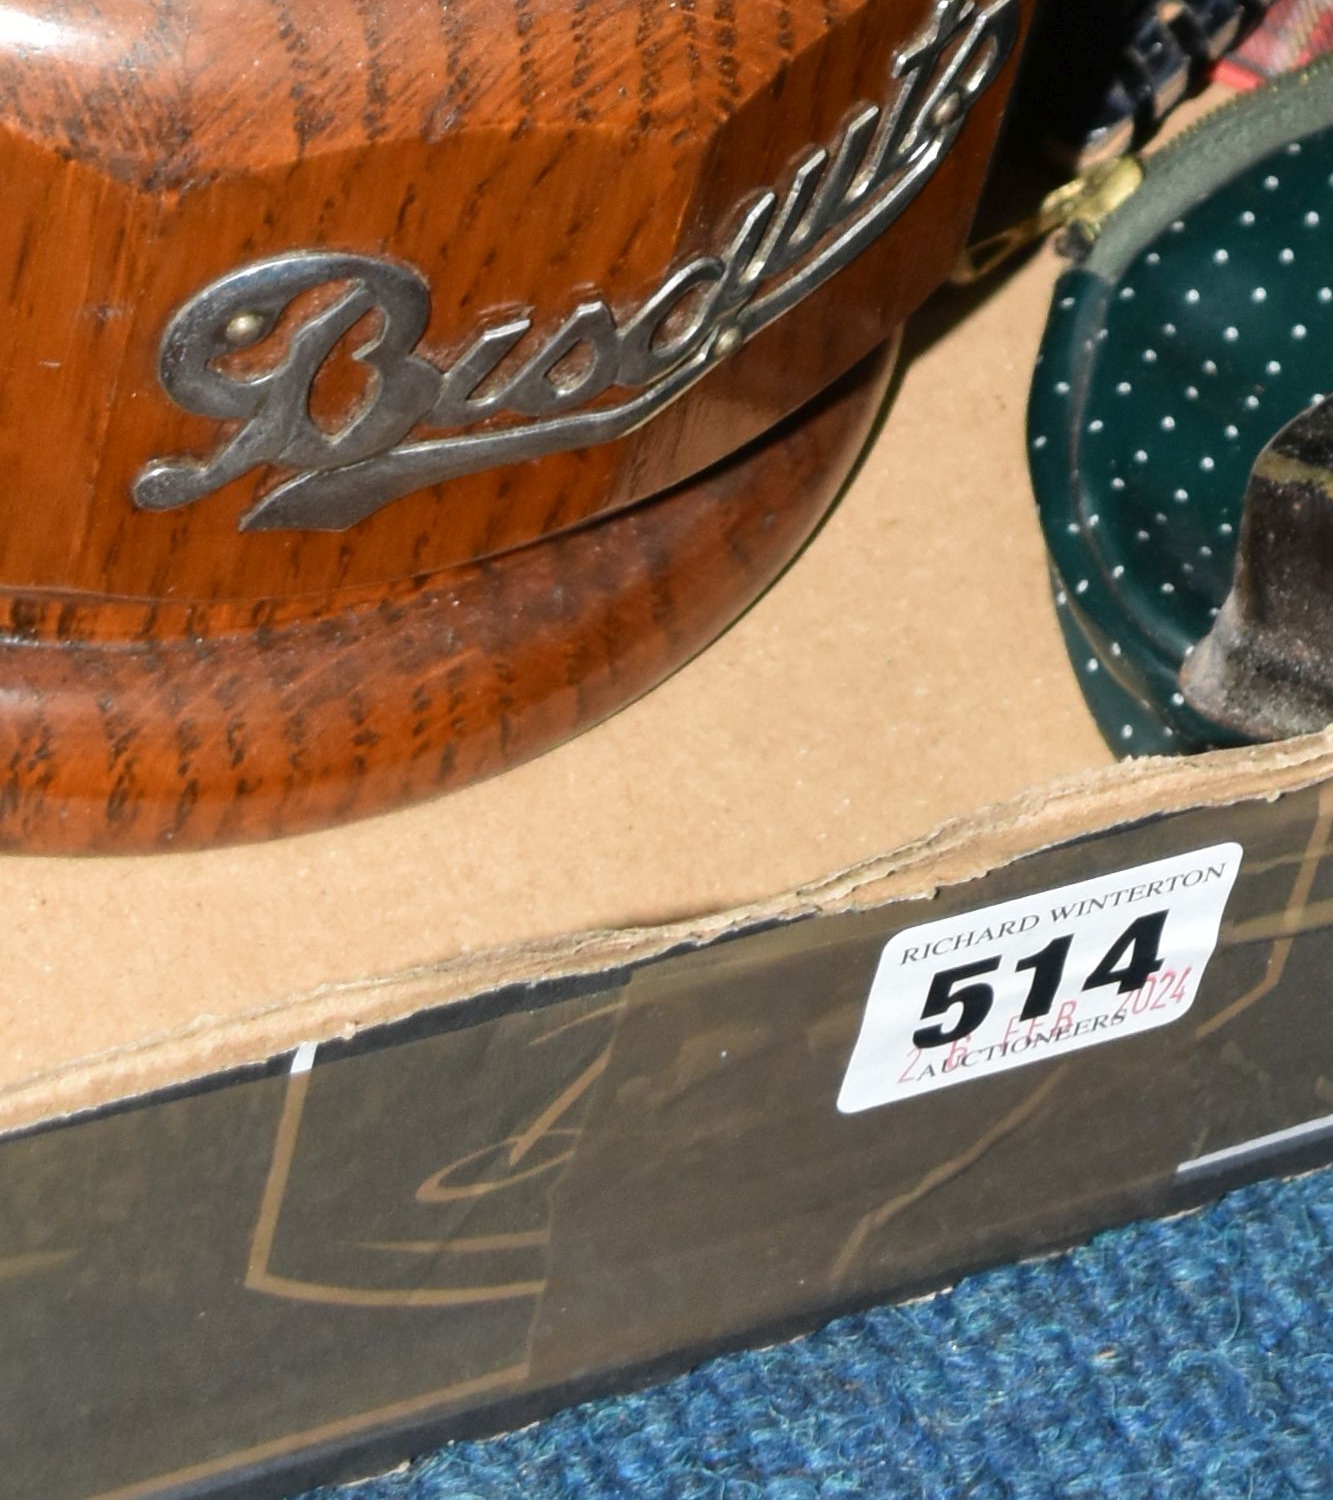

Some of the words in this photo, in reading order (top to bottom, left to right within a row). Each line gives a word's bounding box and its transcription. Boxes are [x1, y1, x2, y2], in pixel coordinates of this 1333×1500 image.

[900, 913, 1040, 966] RICHARD
[1049, 862, 1227, 924] WINTERTON
[911, 908, 1170, 1050] 514
[916, 1008, 1128, 1082] AUCTIONEERS
